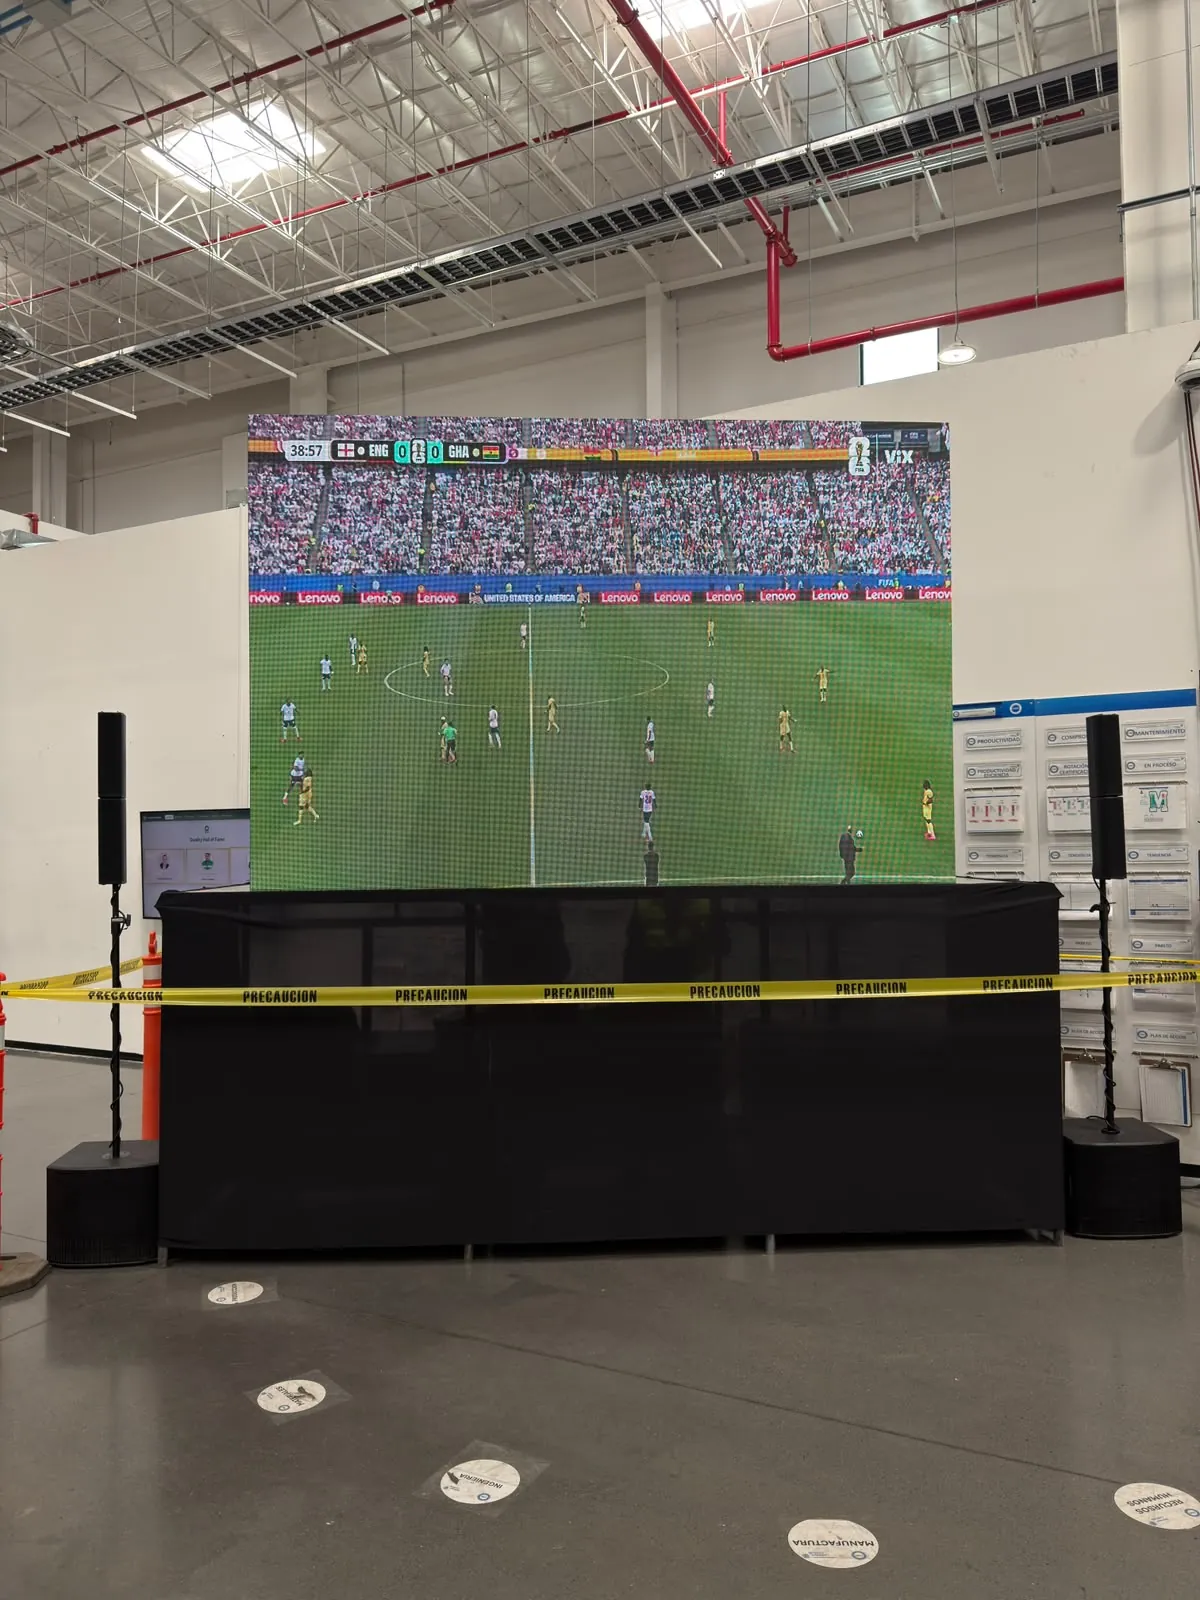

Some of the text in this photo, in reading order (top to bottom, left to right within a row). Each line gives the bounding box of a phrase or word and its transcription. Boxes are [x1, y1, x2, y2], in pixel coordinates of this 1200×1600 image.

[290, 444, 323, 457] 38:57
[368, 444, 389, 457] ENG
[398, 445, 407, 458] 0
[431, 445, 440, 459] 0
[448, 445, 470, 458] GHA
[250, 593, 280, 603] novo
[298, 592, 341, 603] Lenovo
[417, 593, 457, 603] Lenovo
[483, 593, 575, 602] UNITED STATES OF AMERICA
[601, 592, 639, 603] Lenovo
[654, 592, 691, 602] Lenovo
[706, 591, 743, 602] Lenovo
[760, 591, 796, 601] Lenovo
[812, 590, 849, 601] Lenovo
[865, 589, 903, 600] Lenovo
[1134, 728, 1186, 736] MANTENIMIENTO
[88, 972, 1197, 1003] PRECAUCION PRECAUCION PRECAUCION PRECAUCION PRECAUCION PRECAUCION PRECAUCION PRECAUCION
[460, 1473, 503, 1489] INGENIERIA
[1126, 1492, 1173, 1506] HUMANOS
[1135, 1499, 1184, 1514] RECURSOS
